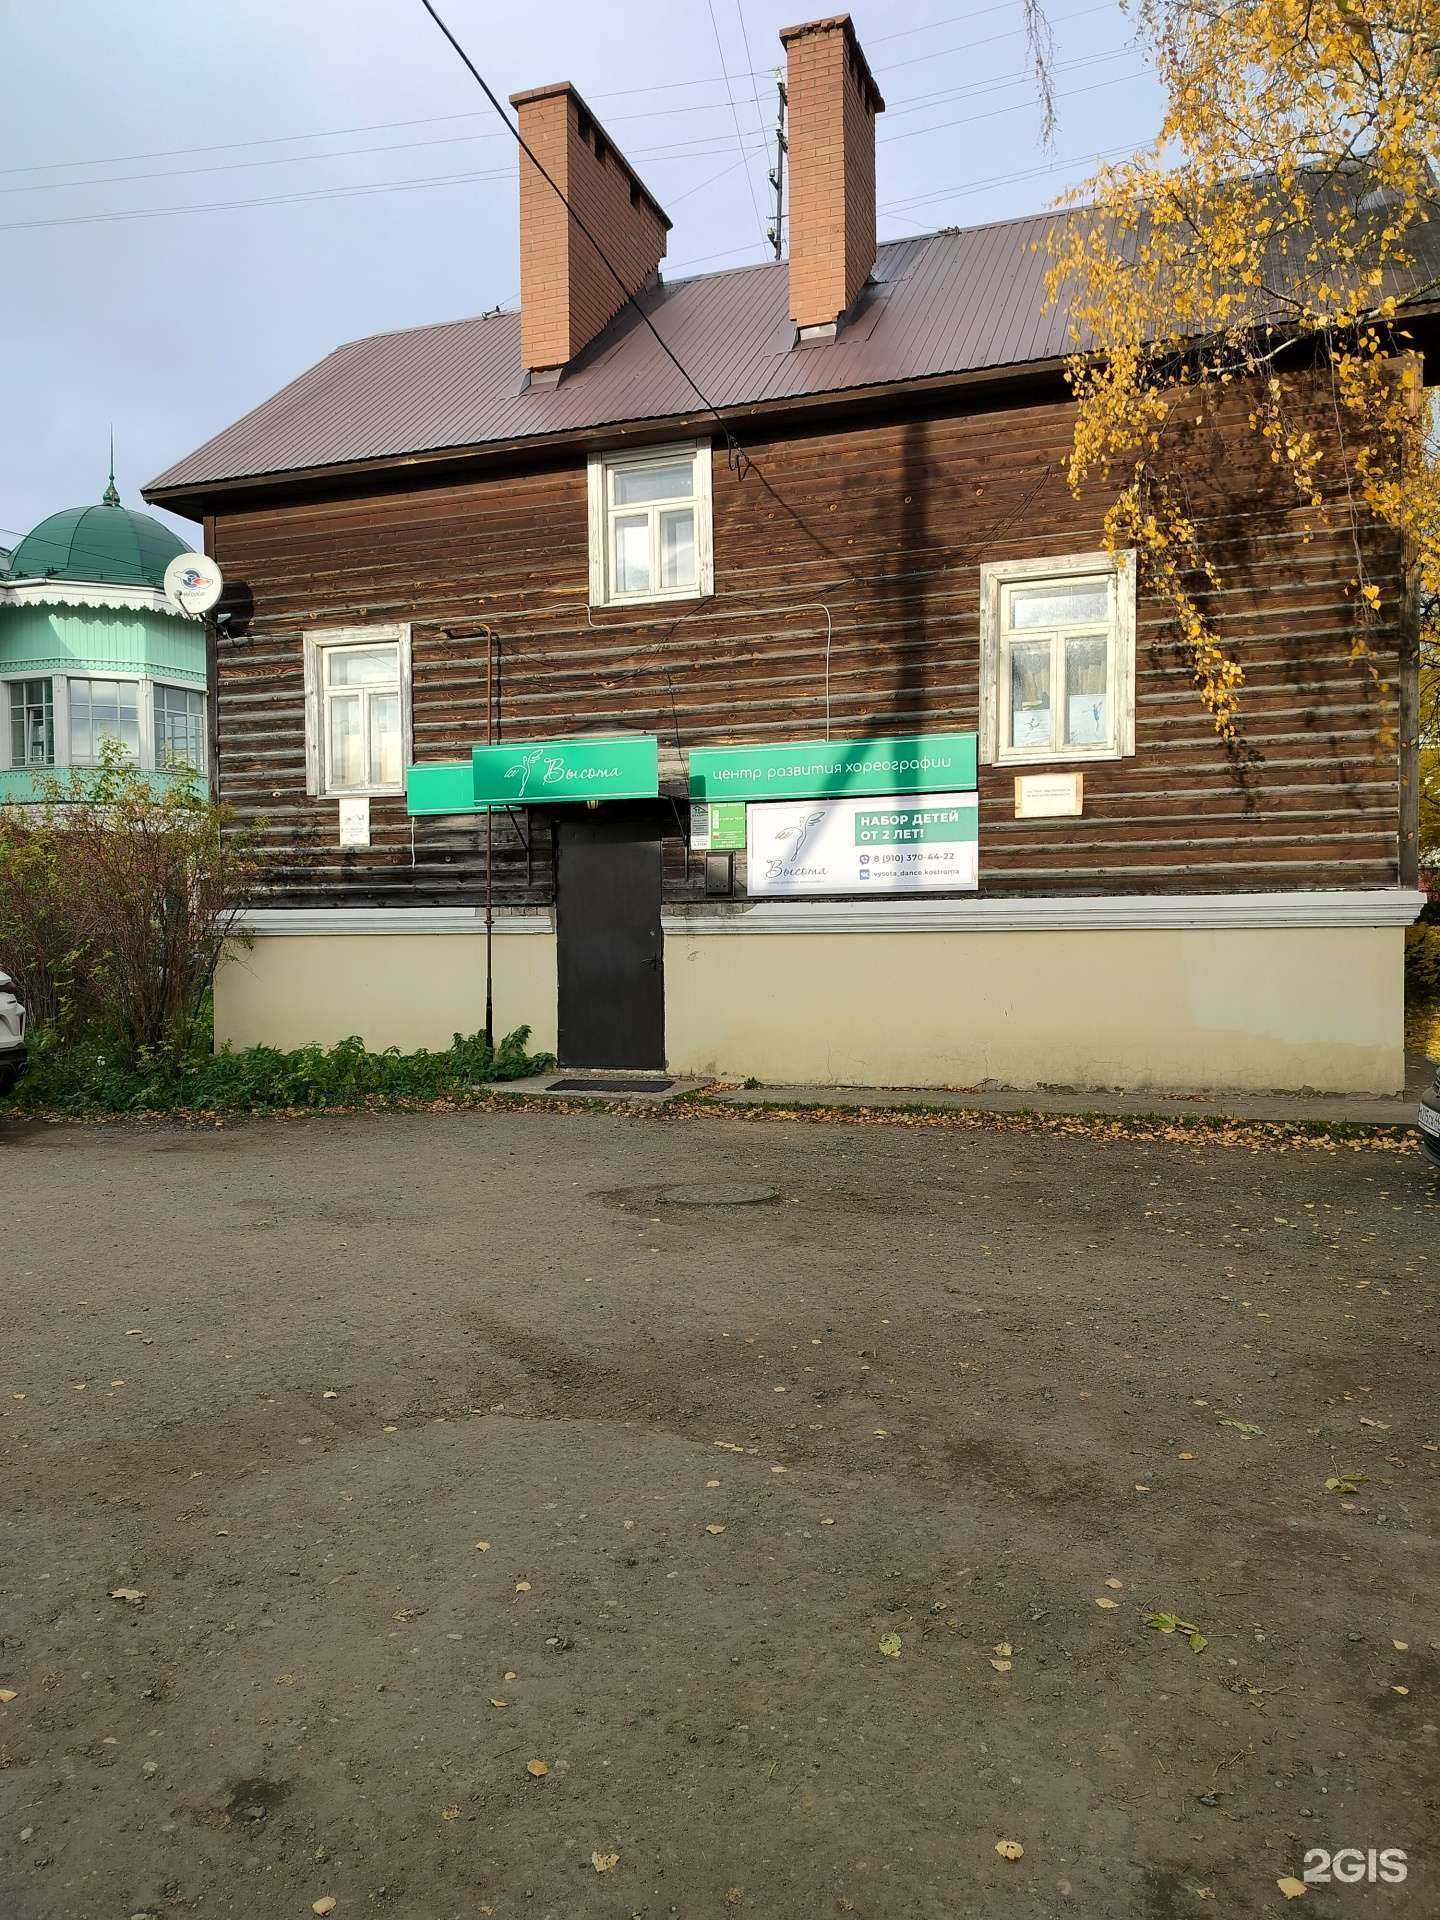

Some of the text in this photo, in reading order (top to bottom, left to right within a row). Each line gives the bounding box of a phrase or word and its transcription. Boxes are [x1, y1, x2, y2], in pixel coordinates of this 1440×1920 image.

[543, 757, 623, 786] Высота
[713, 756, 952, 781] центр развития хореографии
[860, 810, 960, 826] НАБОР ДЕТЕЙ
[860, 828, 924, 841] ОТ 2 ЛЕТ!
[882, 854, 904, 863] (910)
[906, 852, 955, 862] 370-44-22
[765, 859, 829, 878] Высота
